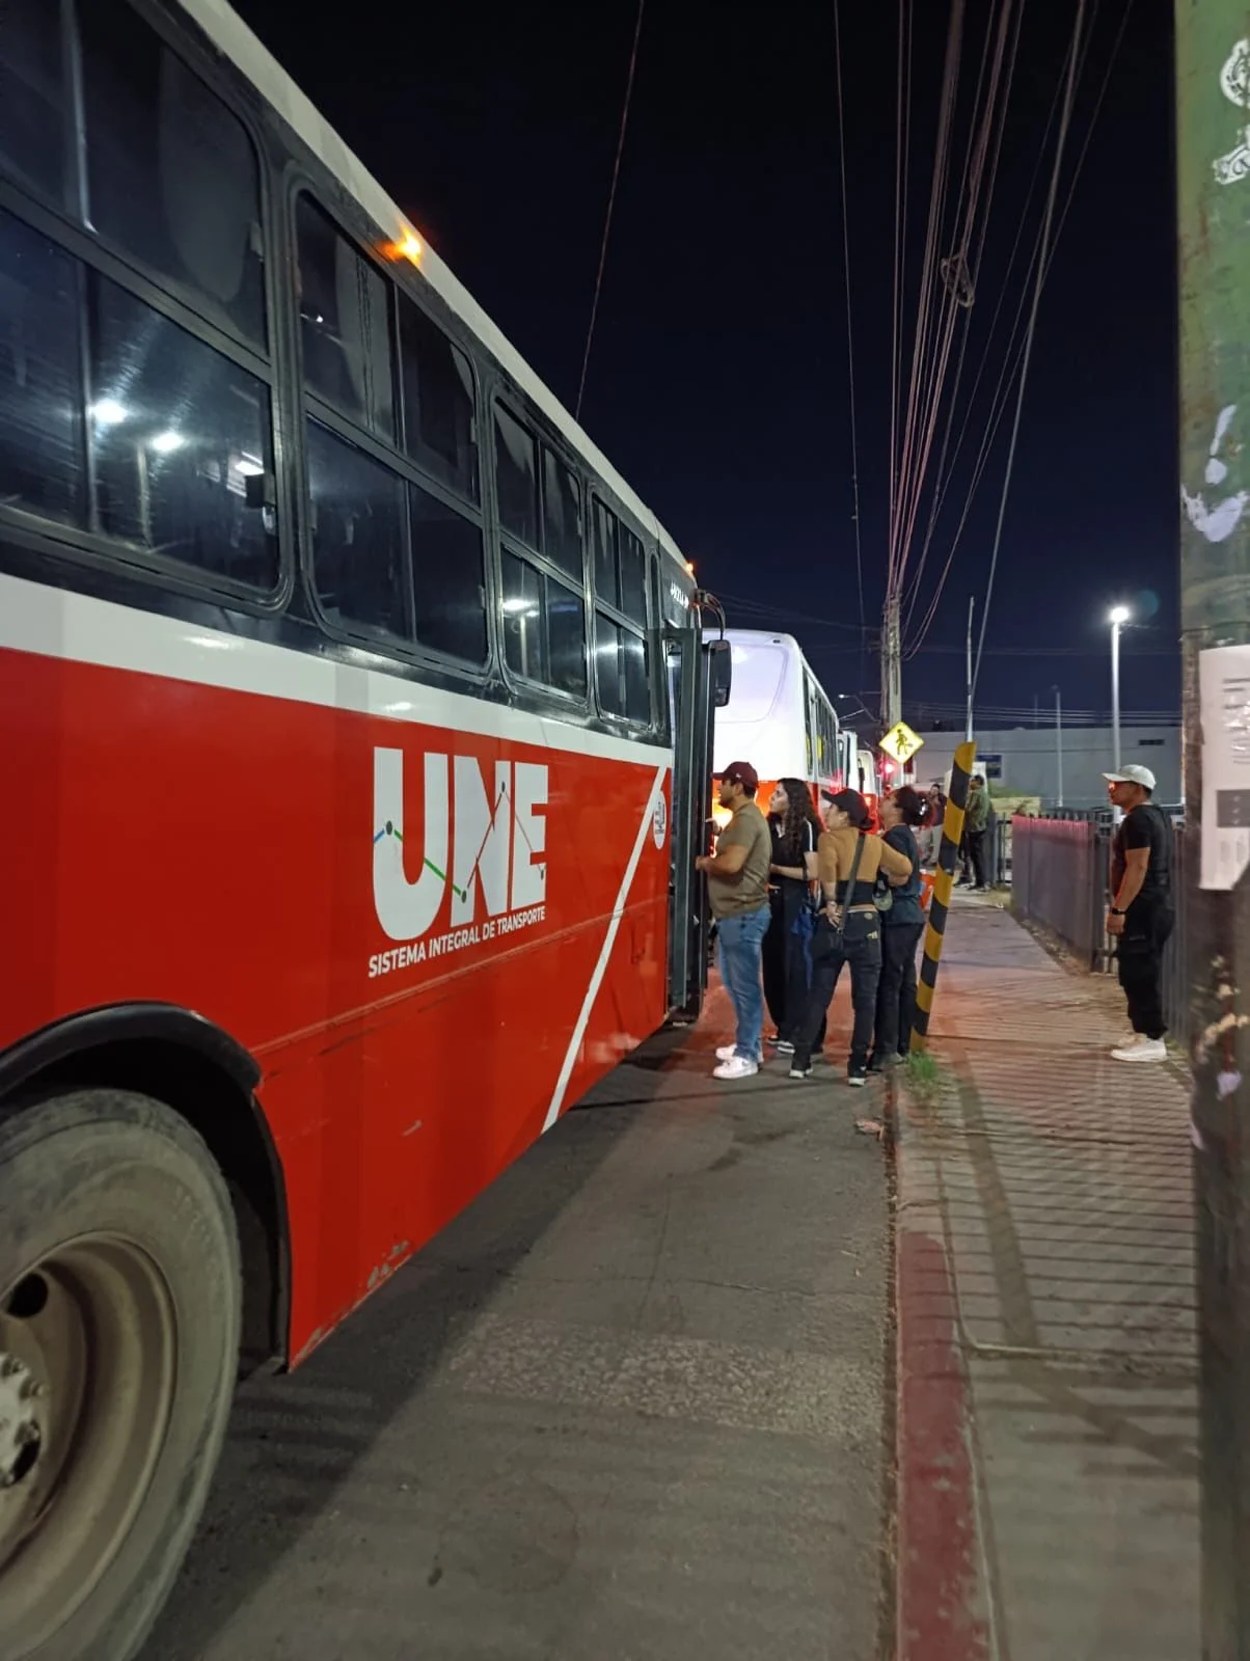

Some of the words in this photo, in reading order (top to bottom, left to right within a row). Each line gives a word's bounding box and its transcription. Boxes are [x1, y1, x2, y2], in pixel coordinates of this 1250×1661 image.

[373, 746, 549, 940] UNE
[368, 942, 426, 978] SISTEMA
[429, 927, 480, 958] INTEGRAL
[482, 924, 495, 941] DE
[497, 906, 546, 934] TRANSPORTE
